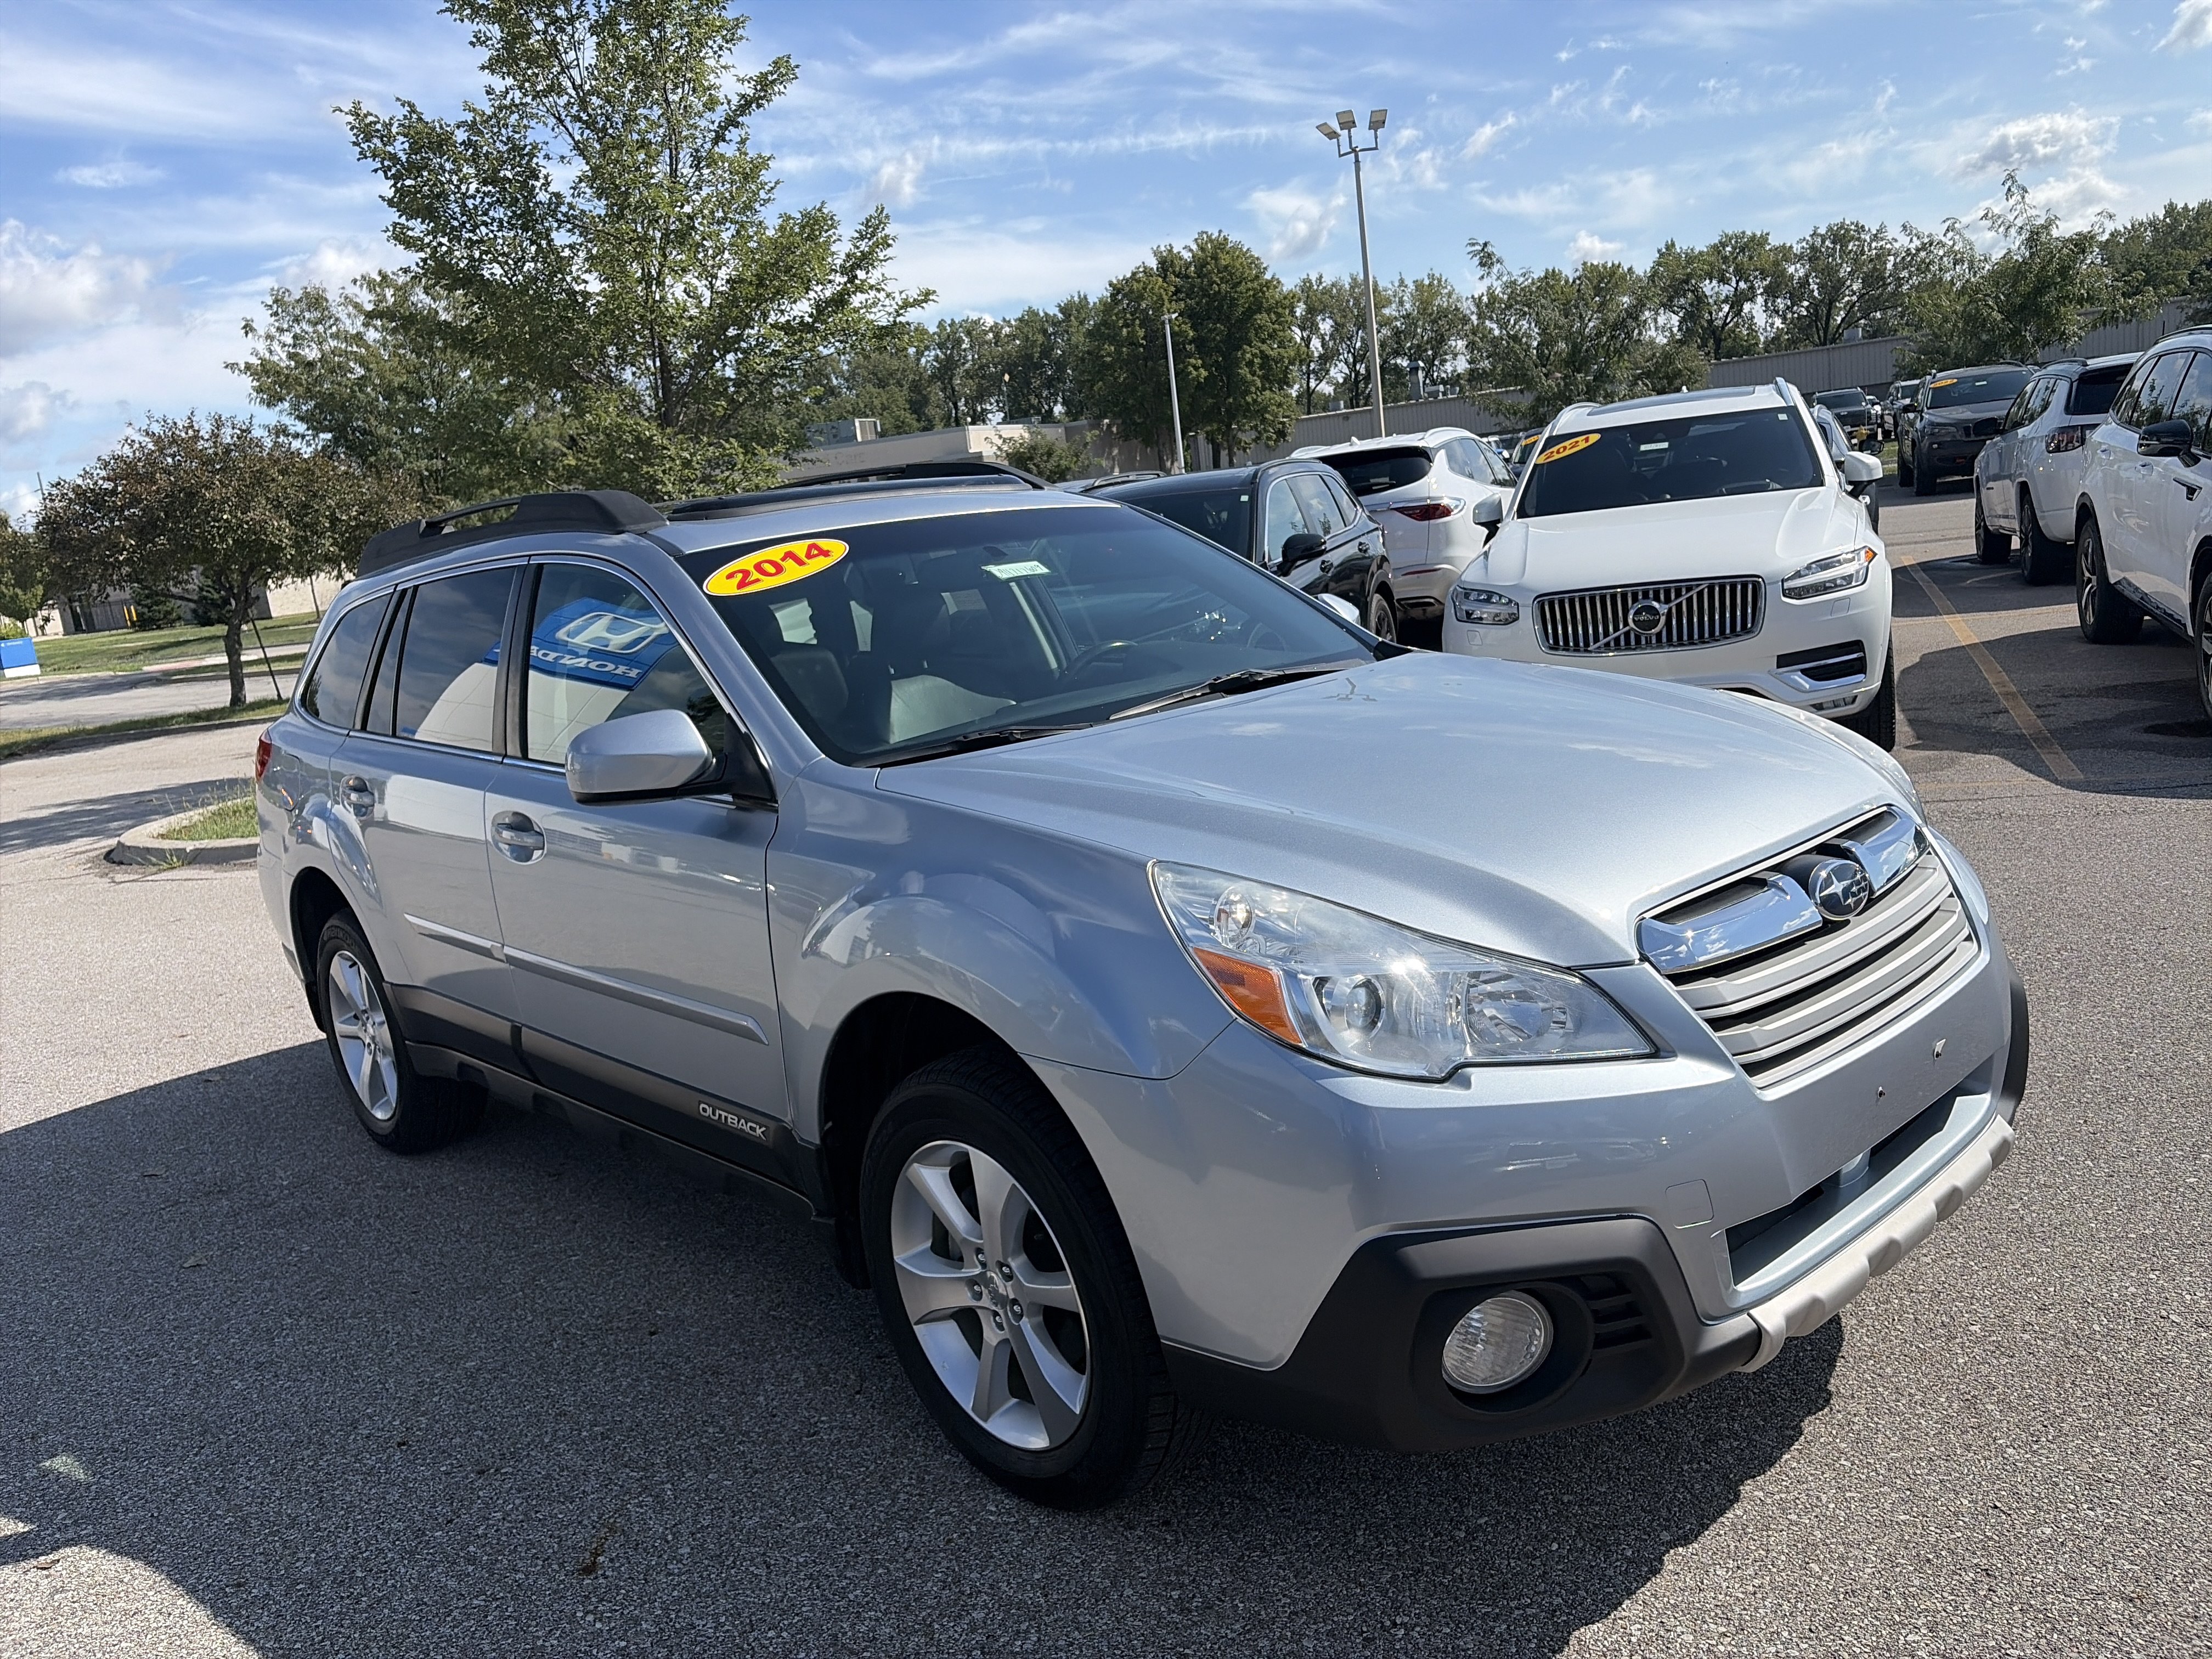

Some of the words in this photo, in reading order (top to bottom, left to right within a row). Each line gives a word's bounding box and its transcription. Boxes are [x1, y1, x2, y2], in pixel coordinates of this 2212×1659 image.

[1543, 436, 1590, 462] 2021
[725, 542, 834, 591] 2014
[699, 1103, 767, 1141] OUTBACK
